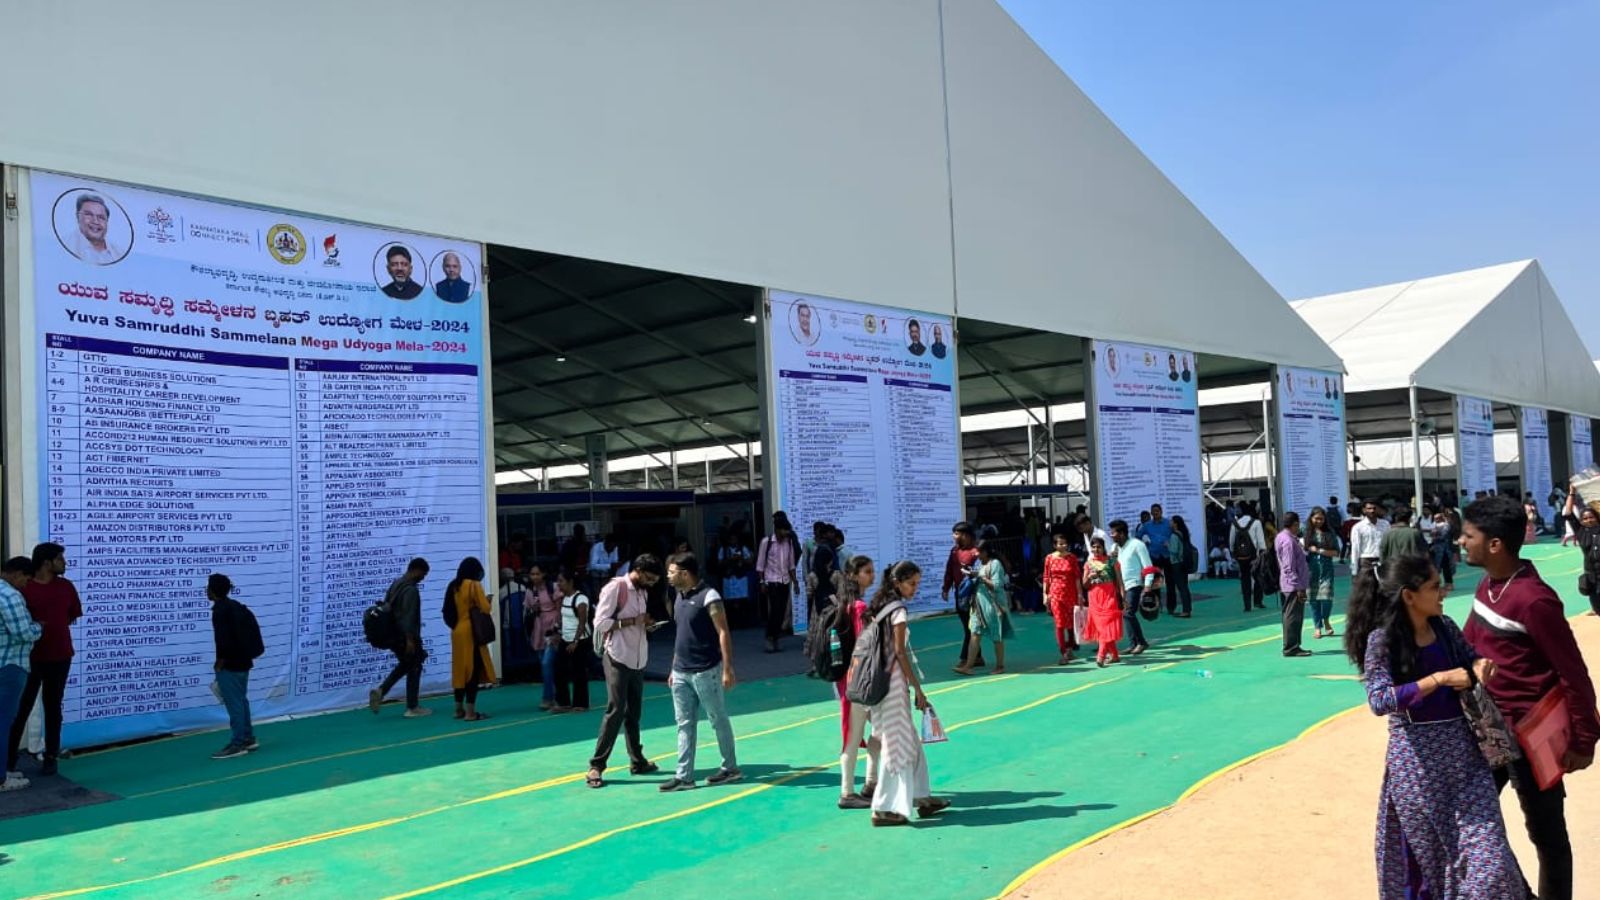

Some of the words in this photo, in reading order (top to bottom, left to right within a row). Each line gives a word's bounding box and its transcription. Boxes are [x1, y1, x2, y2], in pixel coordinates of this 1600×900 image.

[58, 282, 108, 300] ಯುವ
[119, 290, 174, 316] ಸಮೃದ್ಧಿ
[184, 299, 256, 322] ಸಮ್ಮೇಳನ
[264, 309, 311, 328] ಬೃಹತ್
[318, 313, 383, 334] ಉದ್ಯೋಗ
[65, 308, 110, 326] Yuva
[115, 316, 205, 338] Samruddhi
[210, 327, 296, 346] Sammelana
[301, 336, 338, 350] Mega
[343, 338, 392, 353] Udyoga
[396, 340, 468, 353] Mela-2024
[51, 350, 64, 358] 1-2
[83, 353, 107, 362] GTTC
[132, 346, 178, 359] COMPANY
[180, 351, 205, 360] NAME
[90, 365, 122, 375] CUBES
[124, 368, 168, 380] BUSINESS
[170, 373, 216, 384] SOLUTIONS
[84, 376, 90, 384] A
[101, 377, 161, 389] CRUISESHIPS
[85, 385, 141, 397] HOSPITALITY
[144, 389, 179, 400] CAREER
[181, 393, 240, 404] DEVELOPMENT
[85, 396, 123, 406] AADHAR
[125, 399, 165, 409] HOUSING
[168, 402, 204, 411] FINANCE
[52, 417, 62, 425] 10
[101, 420, 152, 430] INSURANCE
[154, 423, 196, 433] BROKERS
[125, 444, 144, 452] DOT
[146, 445, 203, 455] TECHNOLOGY
[86, 454, 103, 462] ACT
[86, 465, 124, 474] ADECCO
[127, 466, 150, 475] INDIA
[152, 468, 187, 476] PRIVATE
[189, 469, 221, 477] LIMITED
[130, 478, 173, 487] RECRUITS
[53, 489, 63, 497] 16
[87, 489, 102, 497] AIR
[105, 489, 129, 497] INDIA
[194, 491, 234, 499] SERVICES
[87, 501, 117, 509] ALPHA
[119, 501, 144, 509] EDGE
[87, 524, 127, 532] AMAZON
[129, 524, 192, 532] DISTRIBUTORS
[88, 535, 106, 543] AML
[109, 535, 147, 543] MOTORS
[149, 535, 166, 543] PVT
[88, 547, 113, 555] AMPS
[115, 546, 161, 554] FACILITIES
[163, 545, 220, 554] MANAGEMENT
[222, 544, 259, 552] SERVICES
[260, 543, 275, 551] PVT
[127, 557, 174, 566] ADVANCED
[177, 556, 224, 565] TECHSERVE
[226, 555, 241, 563] PVT
[243, 555, 257, 563] LTD
[88, 569, 124, 578] APOLLO
[127, 569, 177, 577] HOMECARE
[179, 568, 197, 576] PVT
[87, 581, 124, 590] APOLLO
[127, 580, 175, 589] PHARMACY
[87, 592, 126, 602] AROHAN
[128, 591, 166, 600] FINANCE
[87, 604, 124, 613] APOLLO
[127, 602, 175, 611] MEDSKILLS
[177, 601, 210, 609] LIMITED
[87, 627, 121, 637] ARVIND
[123, 625, 161, 635] MOTORS
[163, 624, 179, 633] PVT
[180, 623, 196, 631] LTD
[86, 639, 124, 649] ASTHRA
[125, 637, 166, 646] DIGITECH
[86, 652, 107, 660] AXIS
[110, 650, 135, 658] BANK
[144, 658, 178, 667] HEALTH
[179, 656, 202, 664] CARE
[119, 672, 132, 680] HR
[134, 669, 175, 679] SERVICES
[86, 685, 118, 696] ADITYA
[147, 679, 182, 689] CAPITAL
[185, 677, 200, 686] LTD
